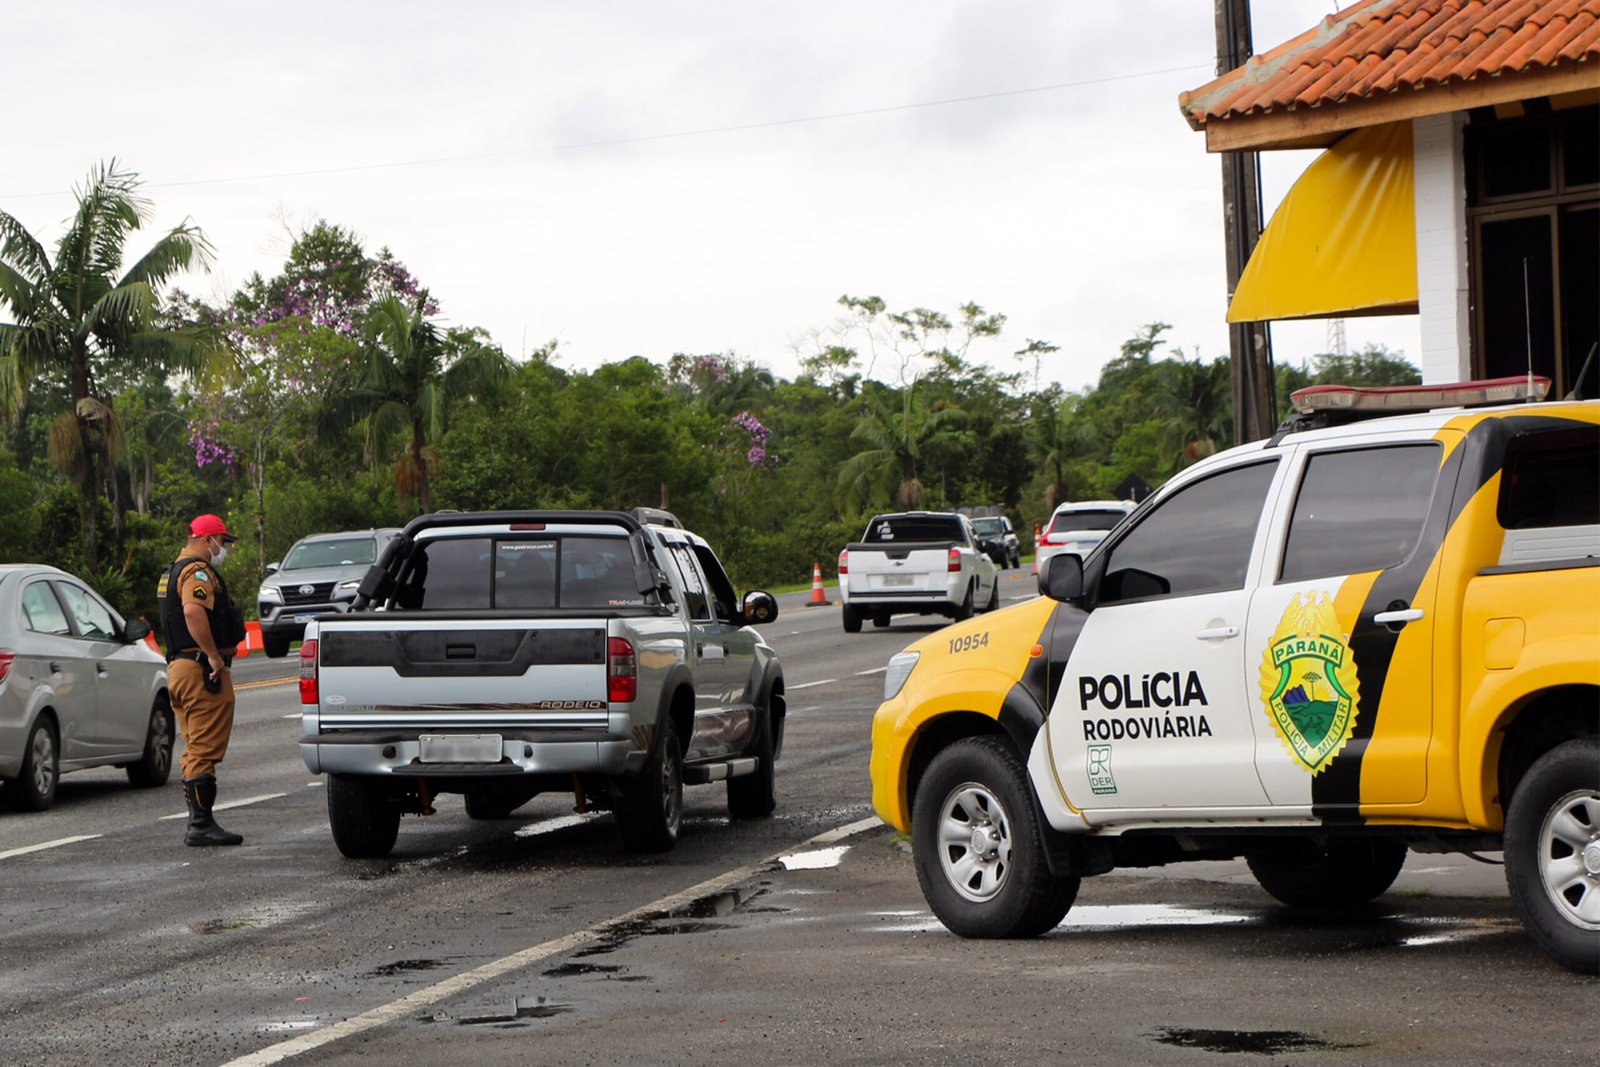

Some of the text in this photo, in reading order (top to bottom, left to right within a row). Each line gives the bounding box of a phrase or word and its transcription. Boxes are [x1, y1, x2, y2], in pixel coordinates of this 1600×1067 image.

[949, 631, 989, 655] 10954
[1275, 640, 1340, 662] PARANÁ
[540, 700, 601, 709] RODEIO
[1083, 710, 1213, 741] RODOVIÁRIA
[1317, 702, 1348, 756] MILITAR
[1091, 777, 1113, 787] DER
